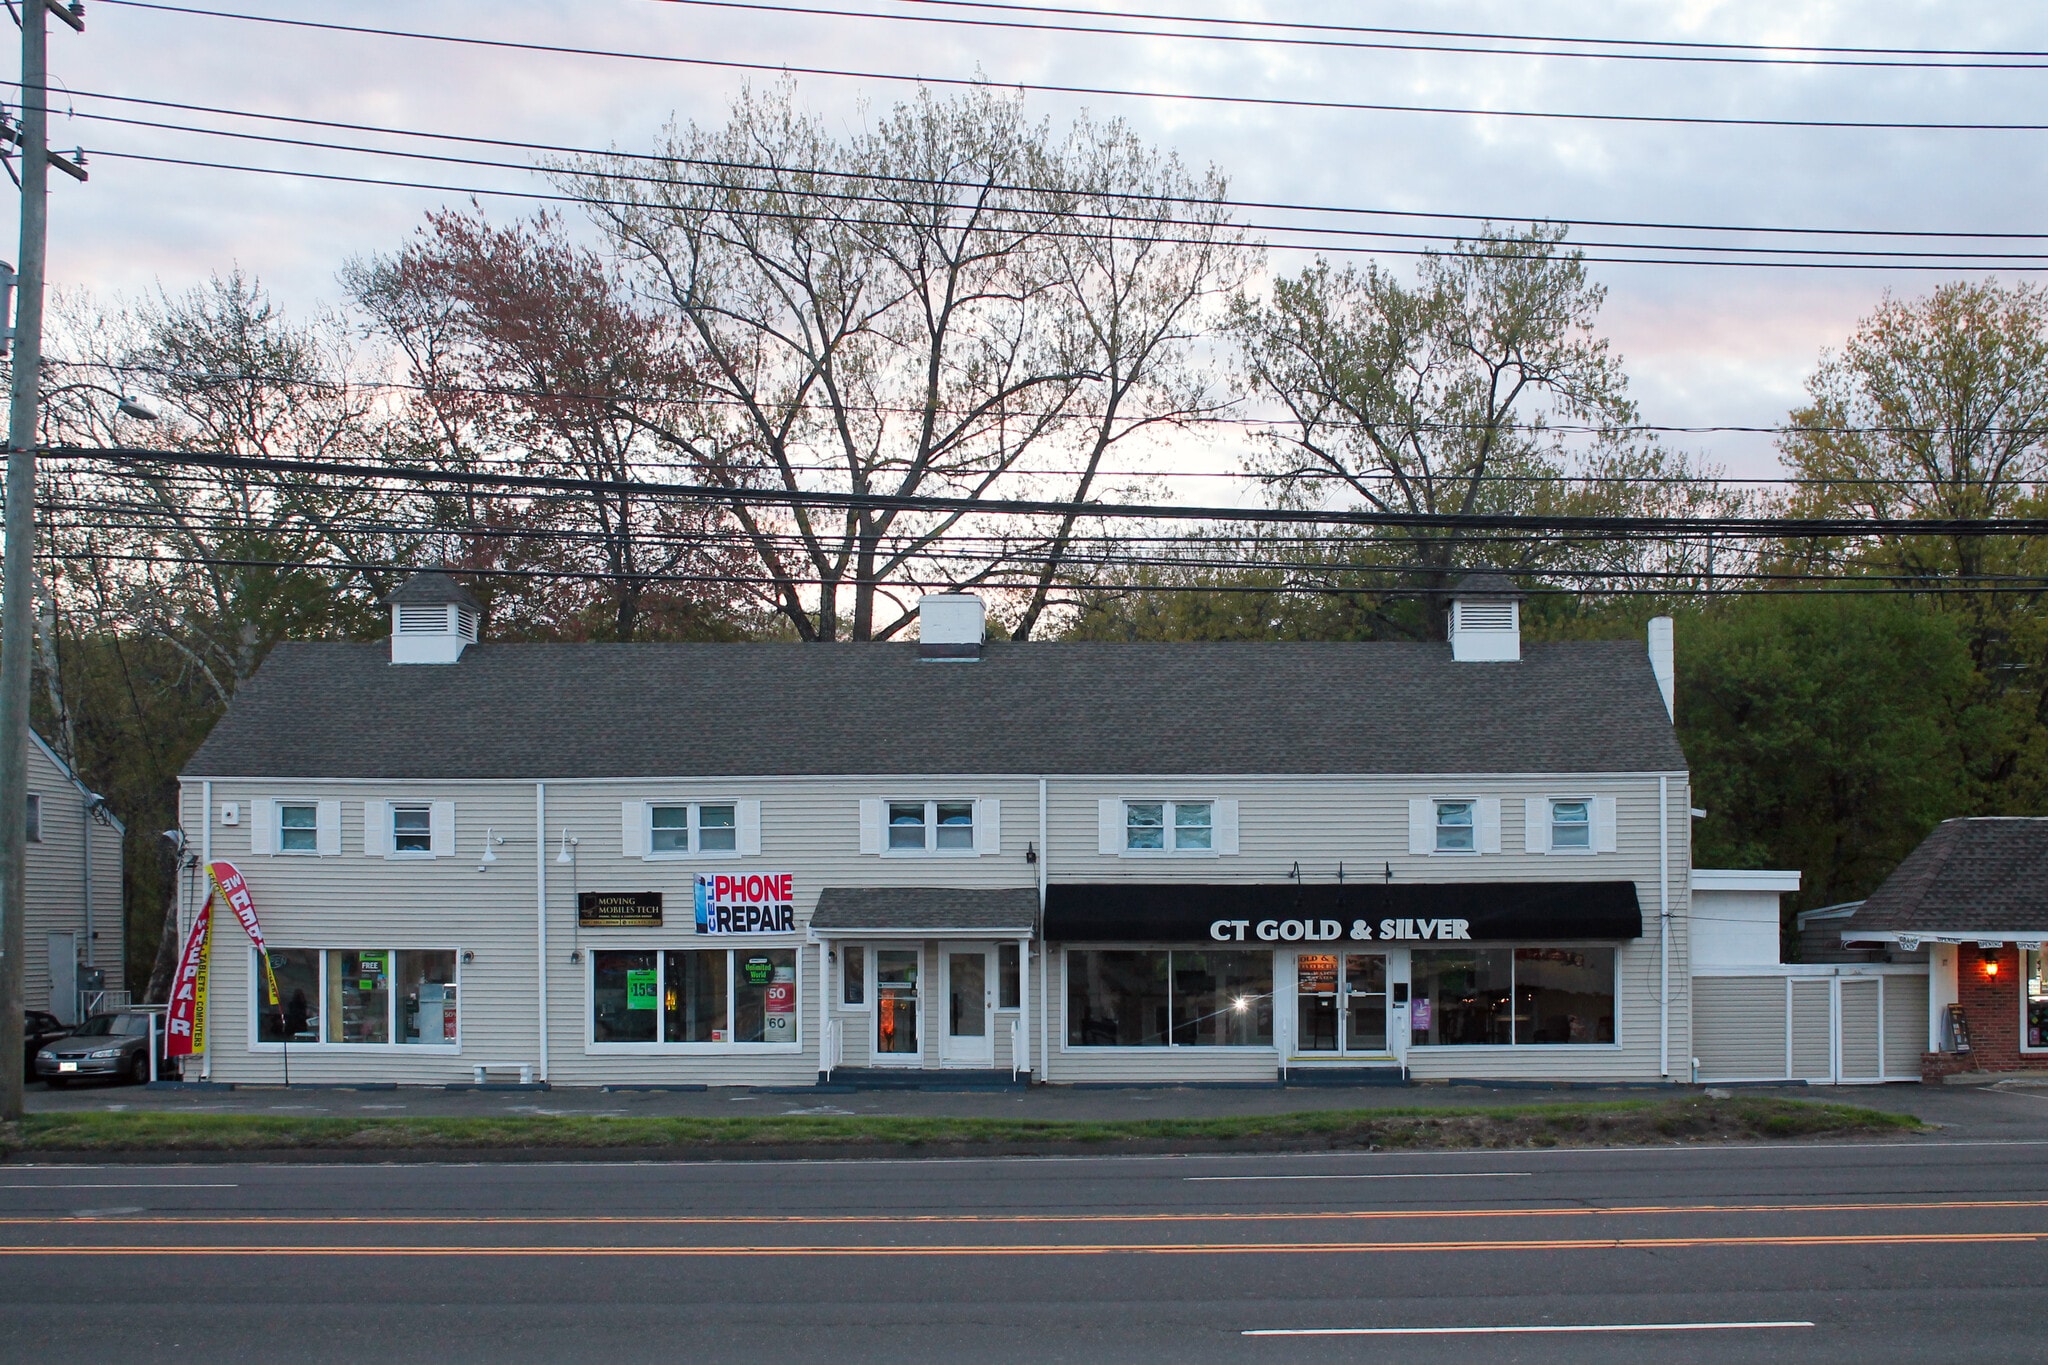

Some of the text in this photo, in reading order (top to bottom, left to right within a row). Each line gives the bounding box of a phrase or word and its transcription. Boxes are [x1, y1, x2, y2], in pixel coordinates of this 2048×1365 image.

[707, 875, 716, 931] CELL
[715, 874, 793, 902] PHONE
[716, 905, 795, 932] REPAIR
[1210, 919, 1472, 941] CT GOLD & SILVER
[198, 953, 207, 992] TABLETS
[194, 1001, 204, 1048] COMPUTERS
